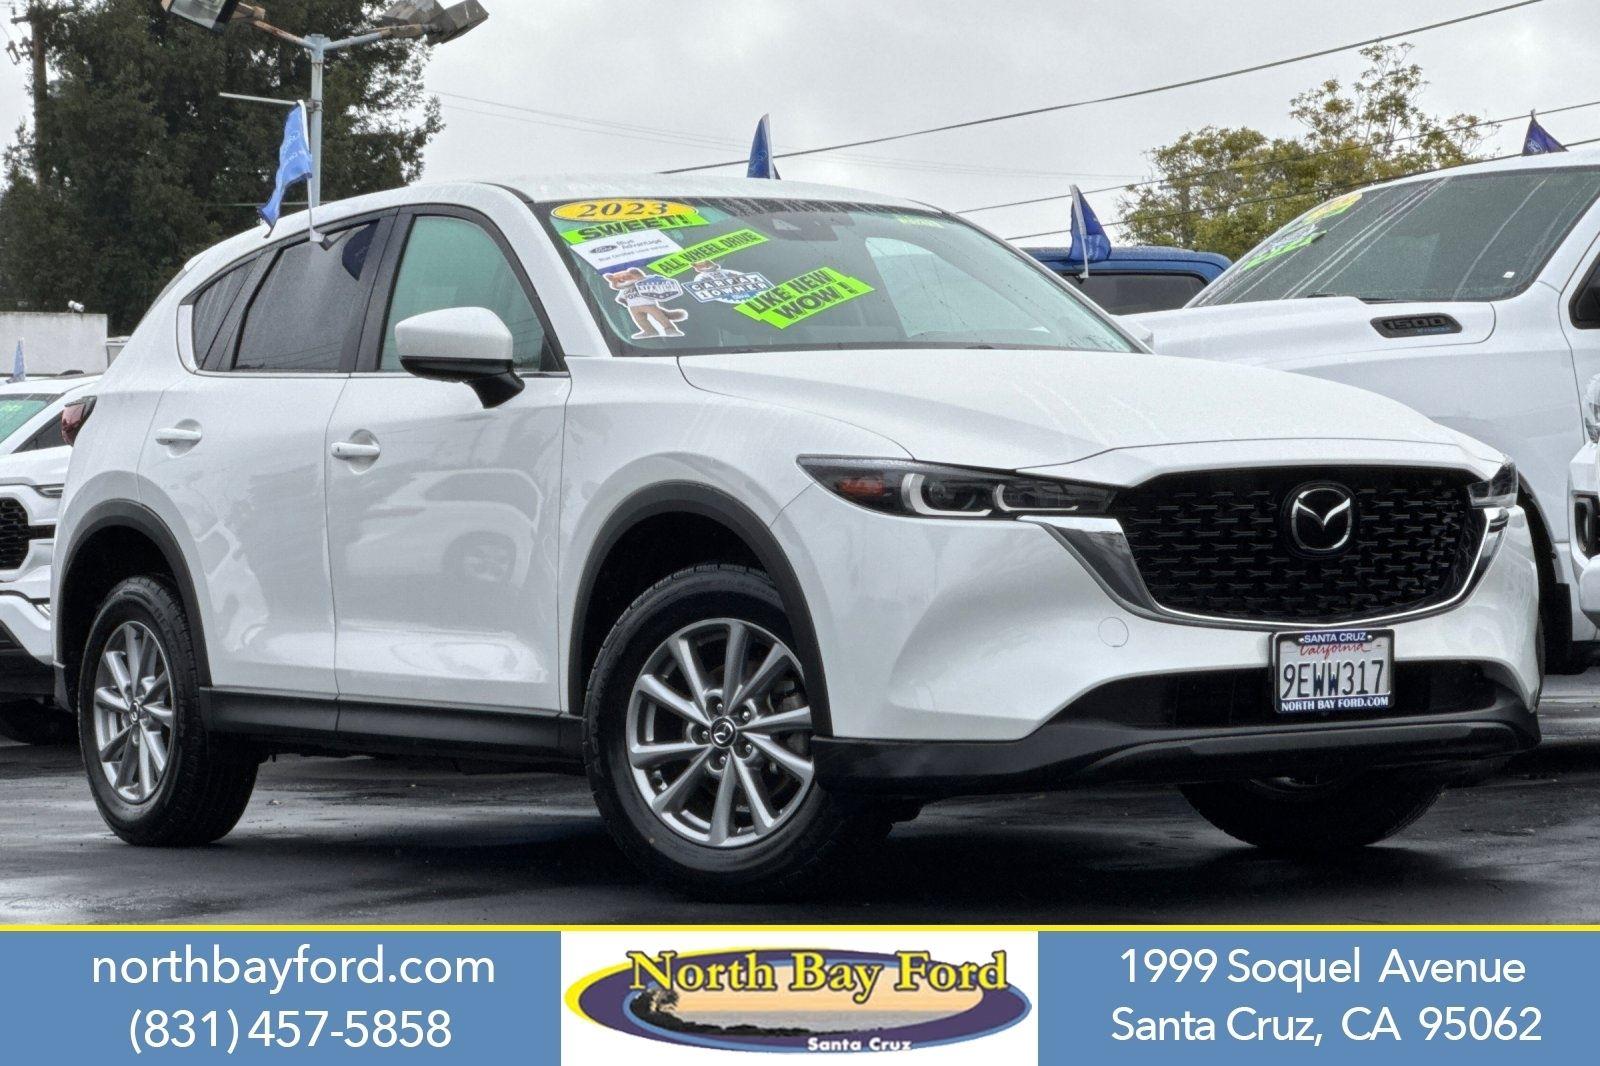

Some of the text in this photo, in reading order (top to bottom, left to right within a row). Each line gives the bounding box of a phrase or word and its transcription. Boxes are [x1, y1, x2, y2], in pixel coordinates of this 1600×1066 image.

[577, 202, 668, 217] 2023
[578, 214, 692, 240] SWEET!
[658, 256, 683, 274] ALL
[681, 242, 724, 264] WHEEL
[724, 231, 760, 248] DRIVE
[691, 274, 764, 291] CARFAX
[711, 282, 767, 297] OWNER
[745, 269, 834, 314] LIKE NEW
[774, 286, 842, 319] WOW
[1383, 316, 1447, 330] 1500
[1304, 632, 1367, 644] SANTA CRUZ
[1300, 643, 1371, 660] California
[1282, 660, 1384, 699] 9EWW317
[1281, 696, 1389, 711] NORTH BAY FORD.COM
